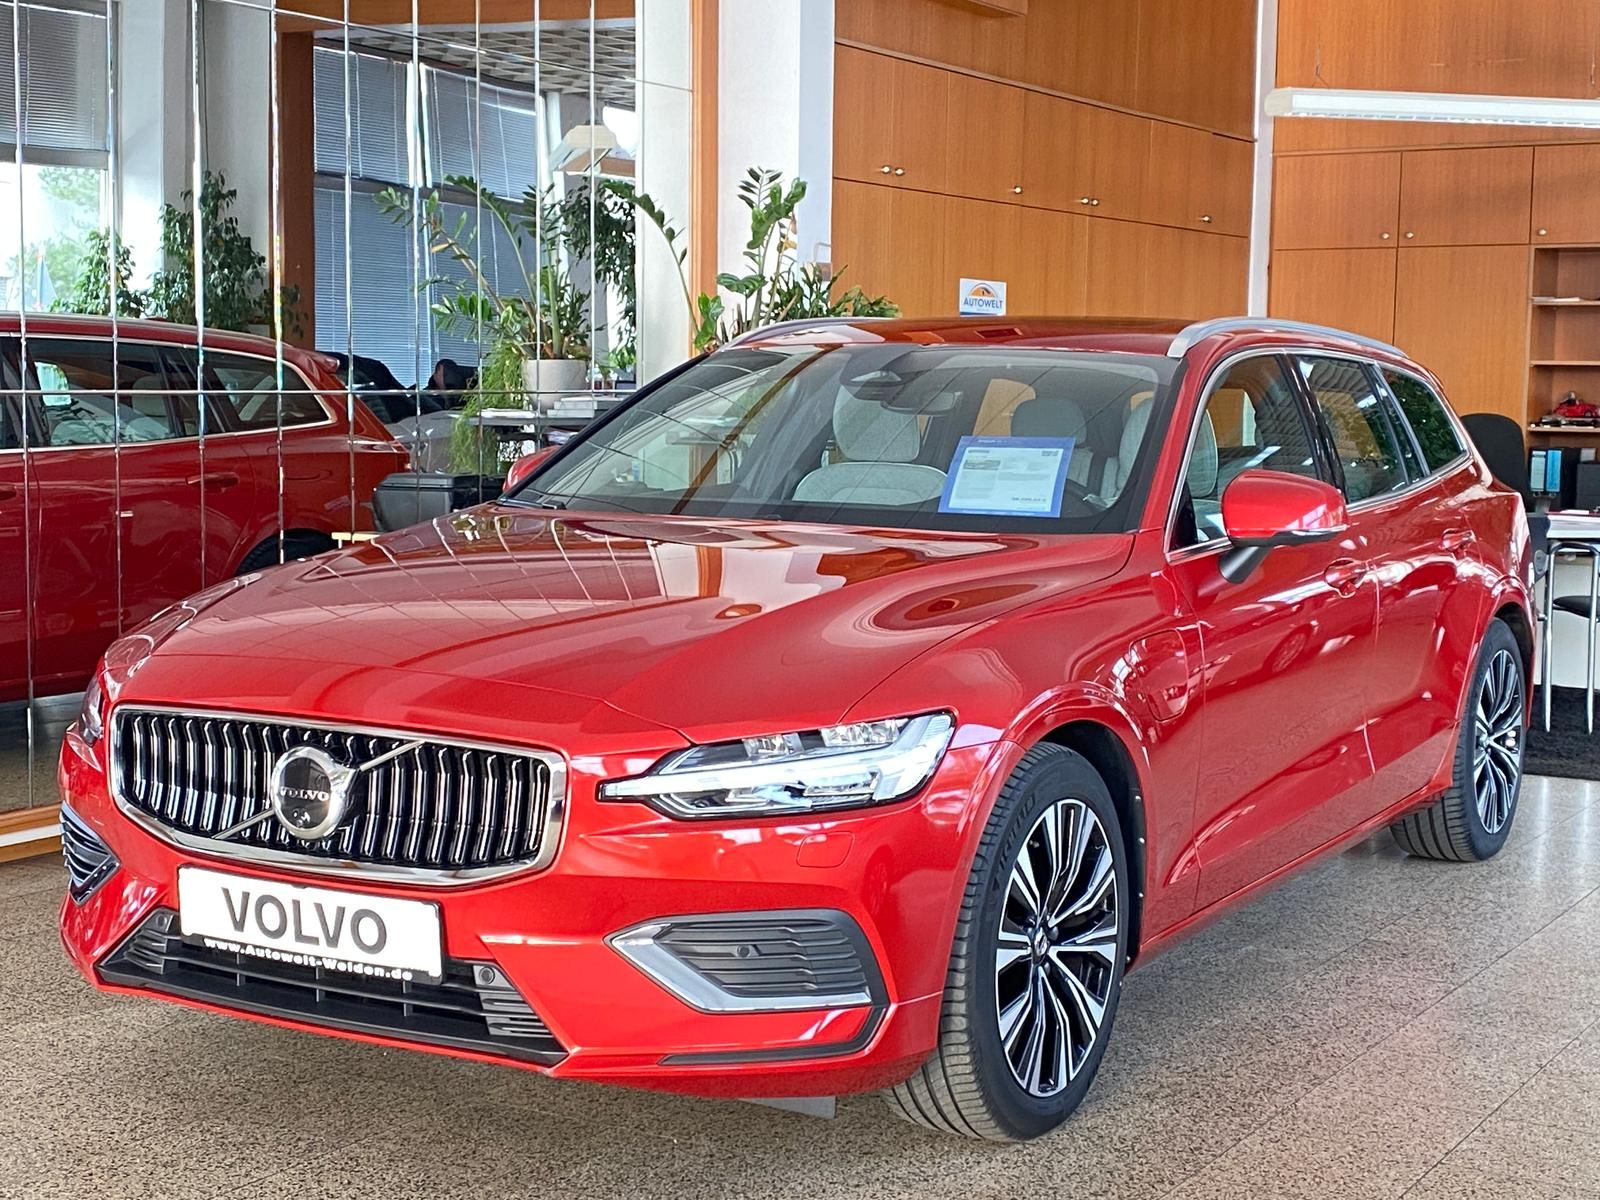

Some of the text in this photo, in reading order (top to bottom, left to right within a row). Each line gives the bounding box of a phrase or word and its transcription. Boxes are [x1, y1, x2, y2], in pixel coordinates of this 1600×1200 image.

[963, 297, 1003, 309] AUTOWELT
[280, 786, 330, 802] VOLVO
[221, 887, 387, 954] VOLVO
